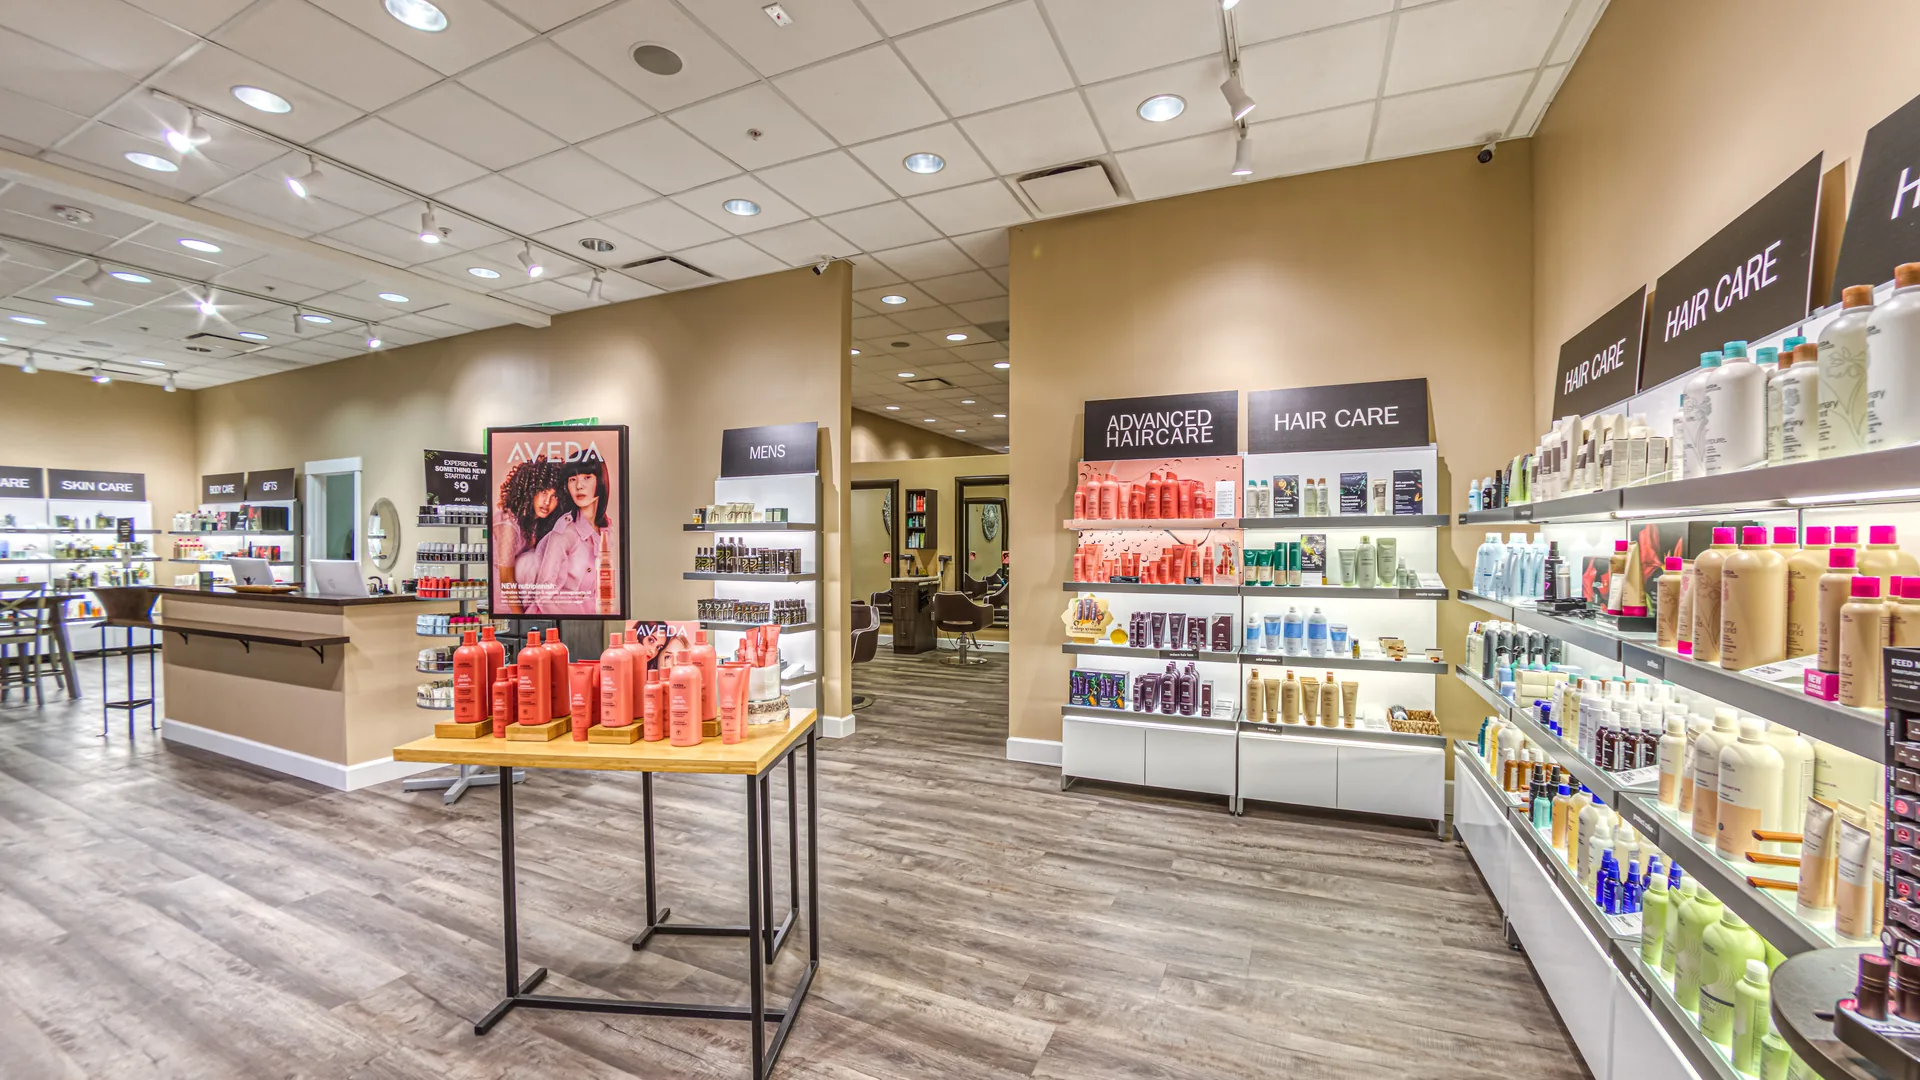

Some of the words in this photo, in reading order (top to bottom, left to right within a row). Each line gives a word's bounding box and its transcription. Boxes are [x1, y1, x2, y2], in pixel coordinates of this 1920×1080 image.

[1664, 288, 1709, 343] HAIR
[1713, 239, 1782, 313] CARE
[1564, 360, 1588, 395] HAIR
[1590, 337, 1627, 381] CARE
[1106, 409, 1213, 432] ADVANCED
[1274, 411, 1327, 432] HAIR
[1334, 405, 1400, 428] CARE
[1106, 425, 1214, 448] HAIRCARE
[506, 440, 604, 464] AVEDA
[749, 443, 786, 460] MENS
[434, 466, 471, 474] SOMETHING
[443, 459, 478, 468] EXPERIENCE
[0, 477, 31, 489] ARE
[61, 480, 96, 492] SKIN
[98, 481, 134, 493] CARE
[209, 485, 221, 494] BODY
[221, 483, 236, 493] CARE
[262, 481, 278, 492] GIFTS
[454, 481, 469, 494] $9
[636, 624, 688, 637] AVEDA
[1891, 658, 1914, 668] FEED
[1807, 673, 1822, 685] NEW
